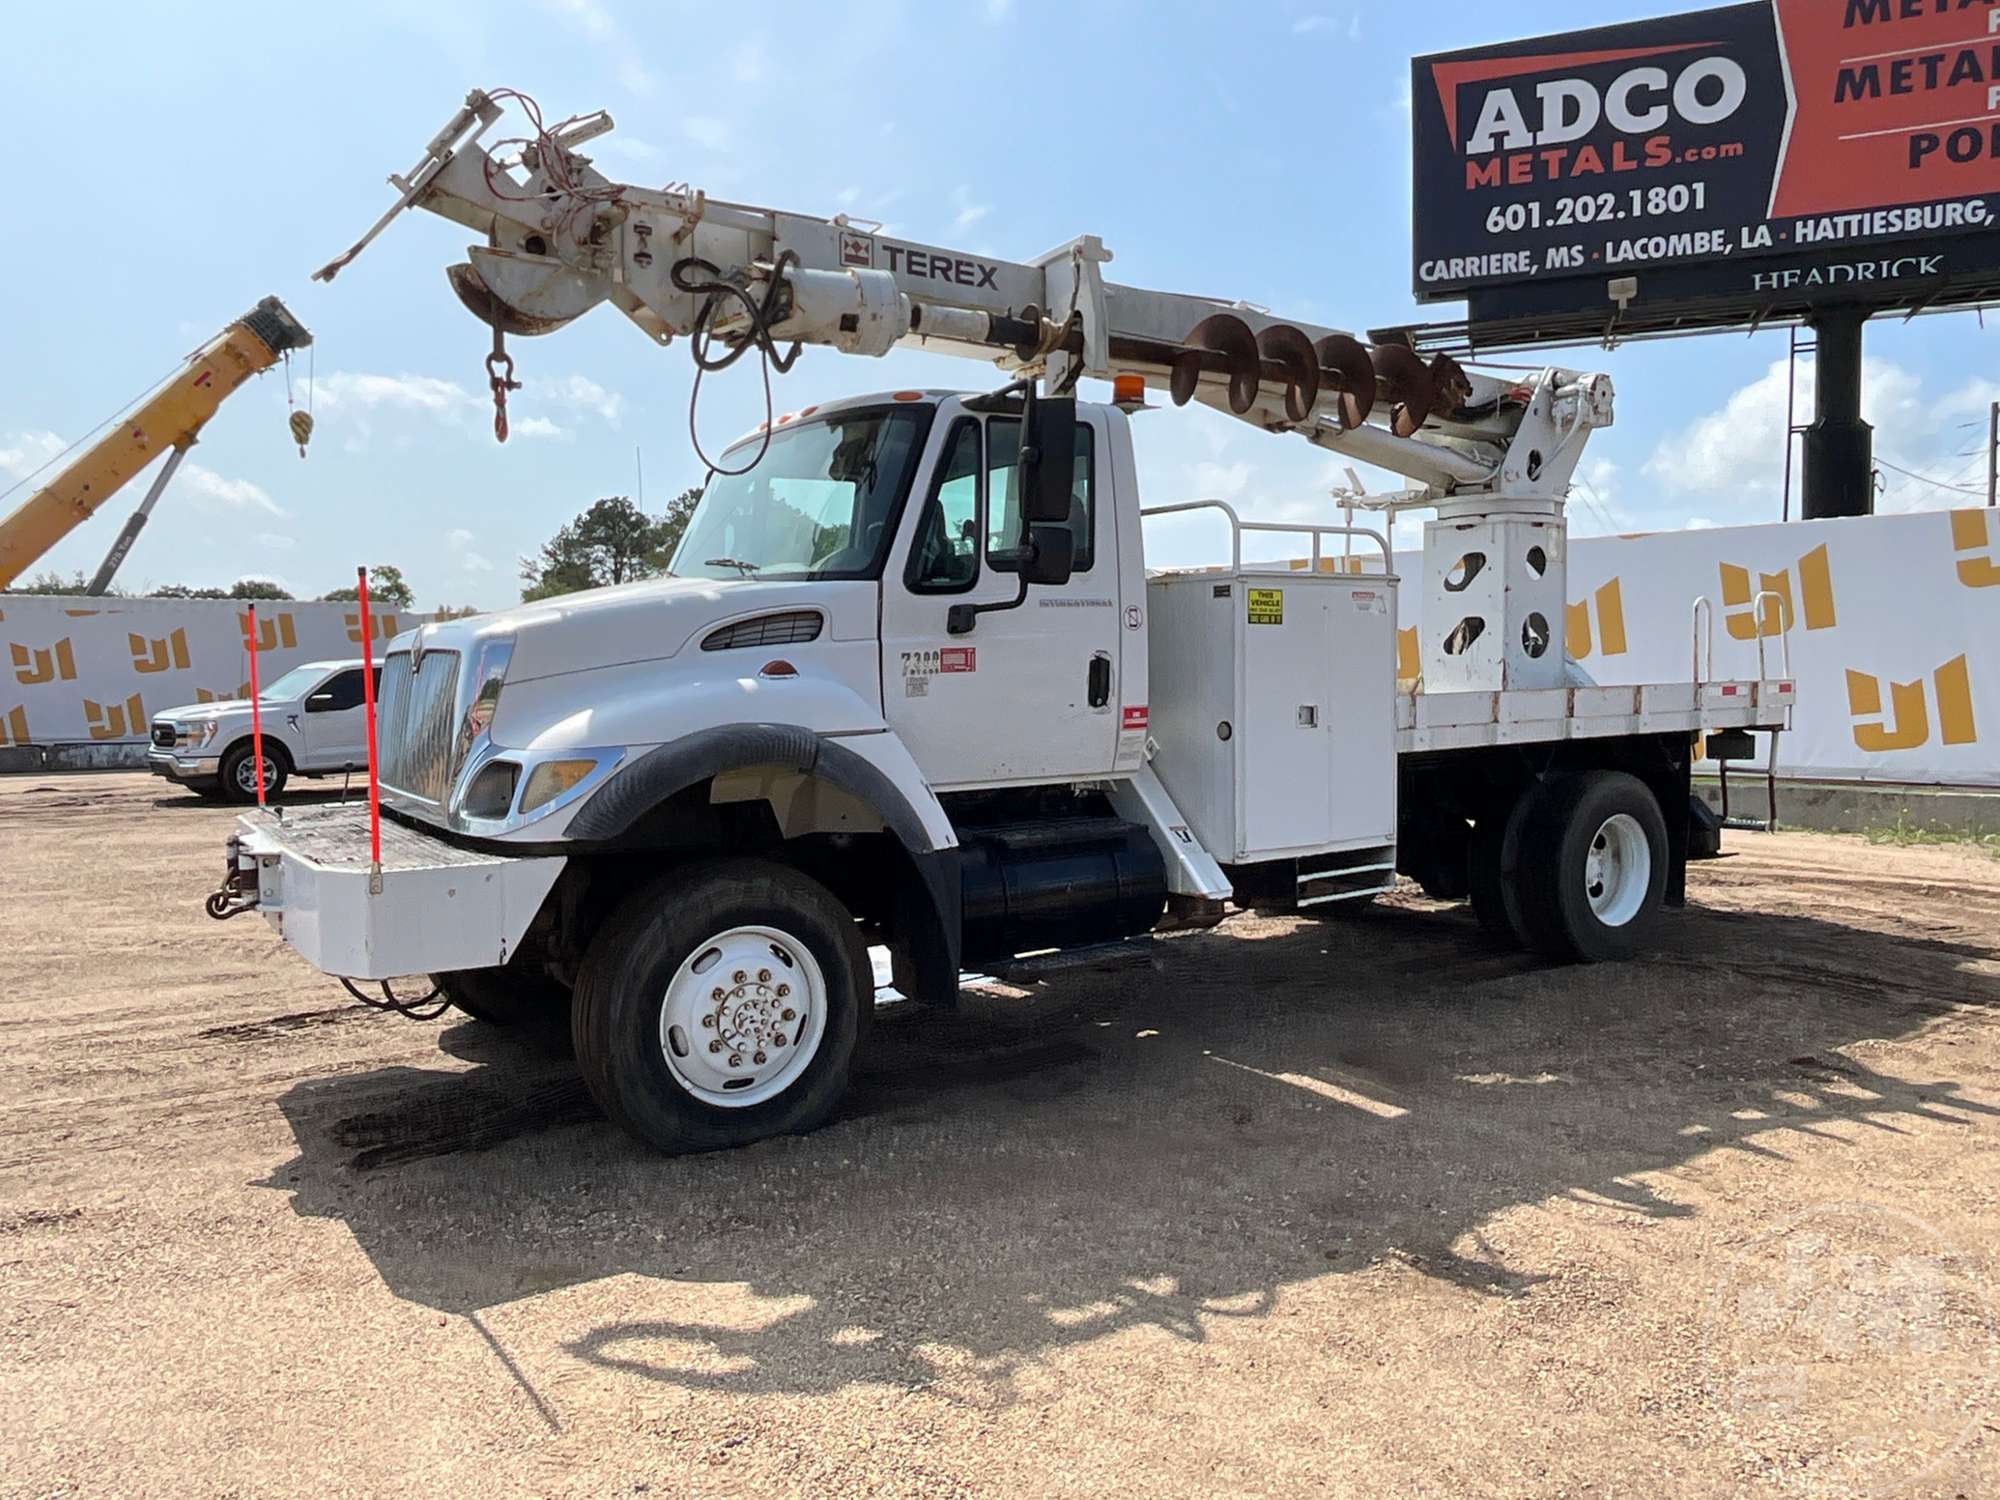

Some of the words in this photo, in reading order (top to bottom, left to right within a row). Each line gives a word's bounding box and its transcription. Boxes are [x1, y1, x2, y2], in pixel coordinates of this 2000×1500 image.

[1466, 56, 1747, 155] ADCO
[1486, 181, 1705, 234] 601.202.1801
[1419, 250, 1539, 282] CARRIERE,
[1545, 245, 1584, 270] MS
[1606, 228, 1733, 264] LACOMBE,
[1741, 224, 1773, 249] LA
[1795, 199, 1995, 245] HATTIESBURG,
[882, 244, 999, 291] TEREX
[1752, 254, 1945, 291] HEADRICK
